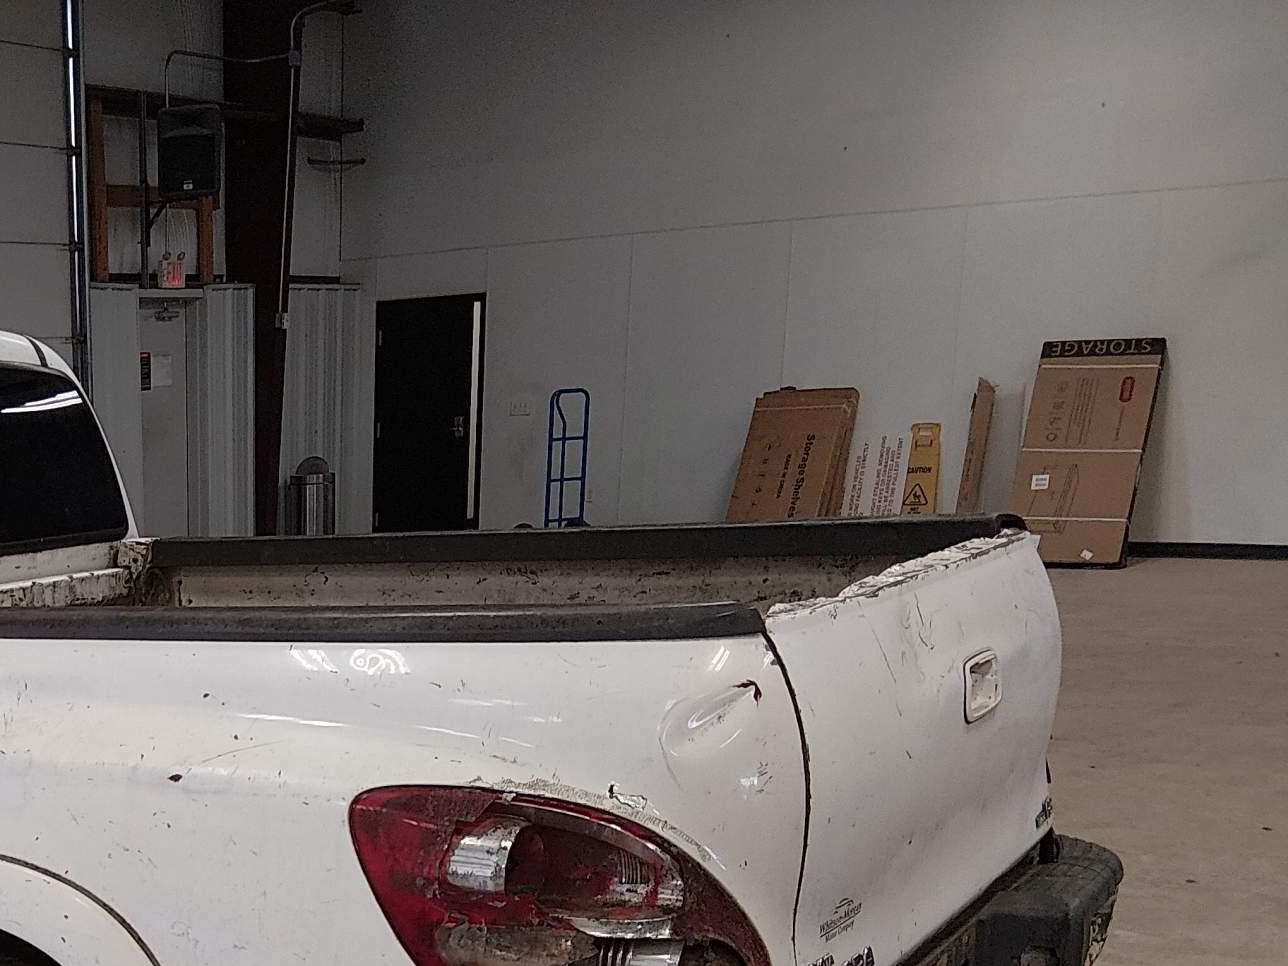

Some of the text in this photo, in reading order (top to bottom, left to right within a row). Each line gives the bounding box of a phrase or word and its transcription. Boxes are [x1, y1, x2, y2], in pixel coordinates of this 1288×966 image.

[1050, 338, 1153, 356] STORAGE
[787, 433, 816, 519] Storage Shelves
[907, 466, 933, 475] CAUTION
